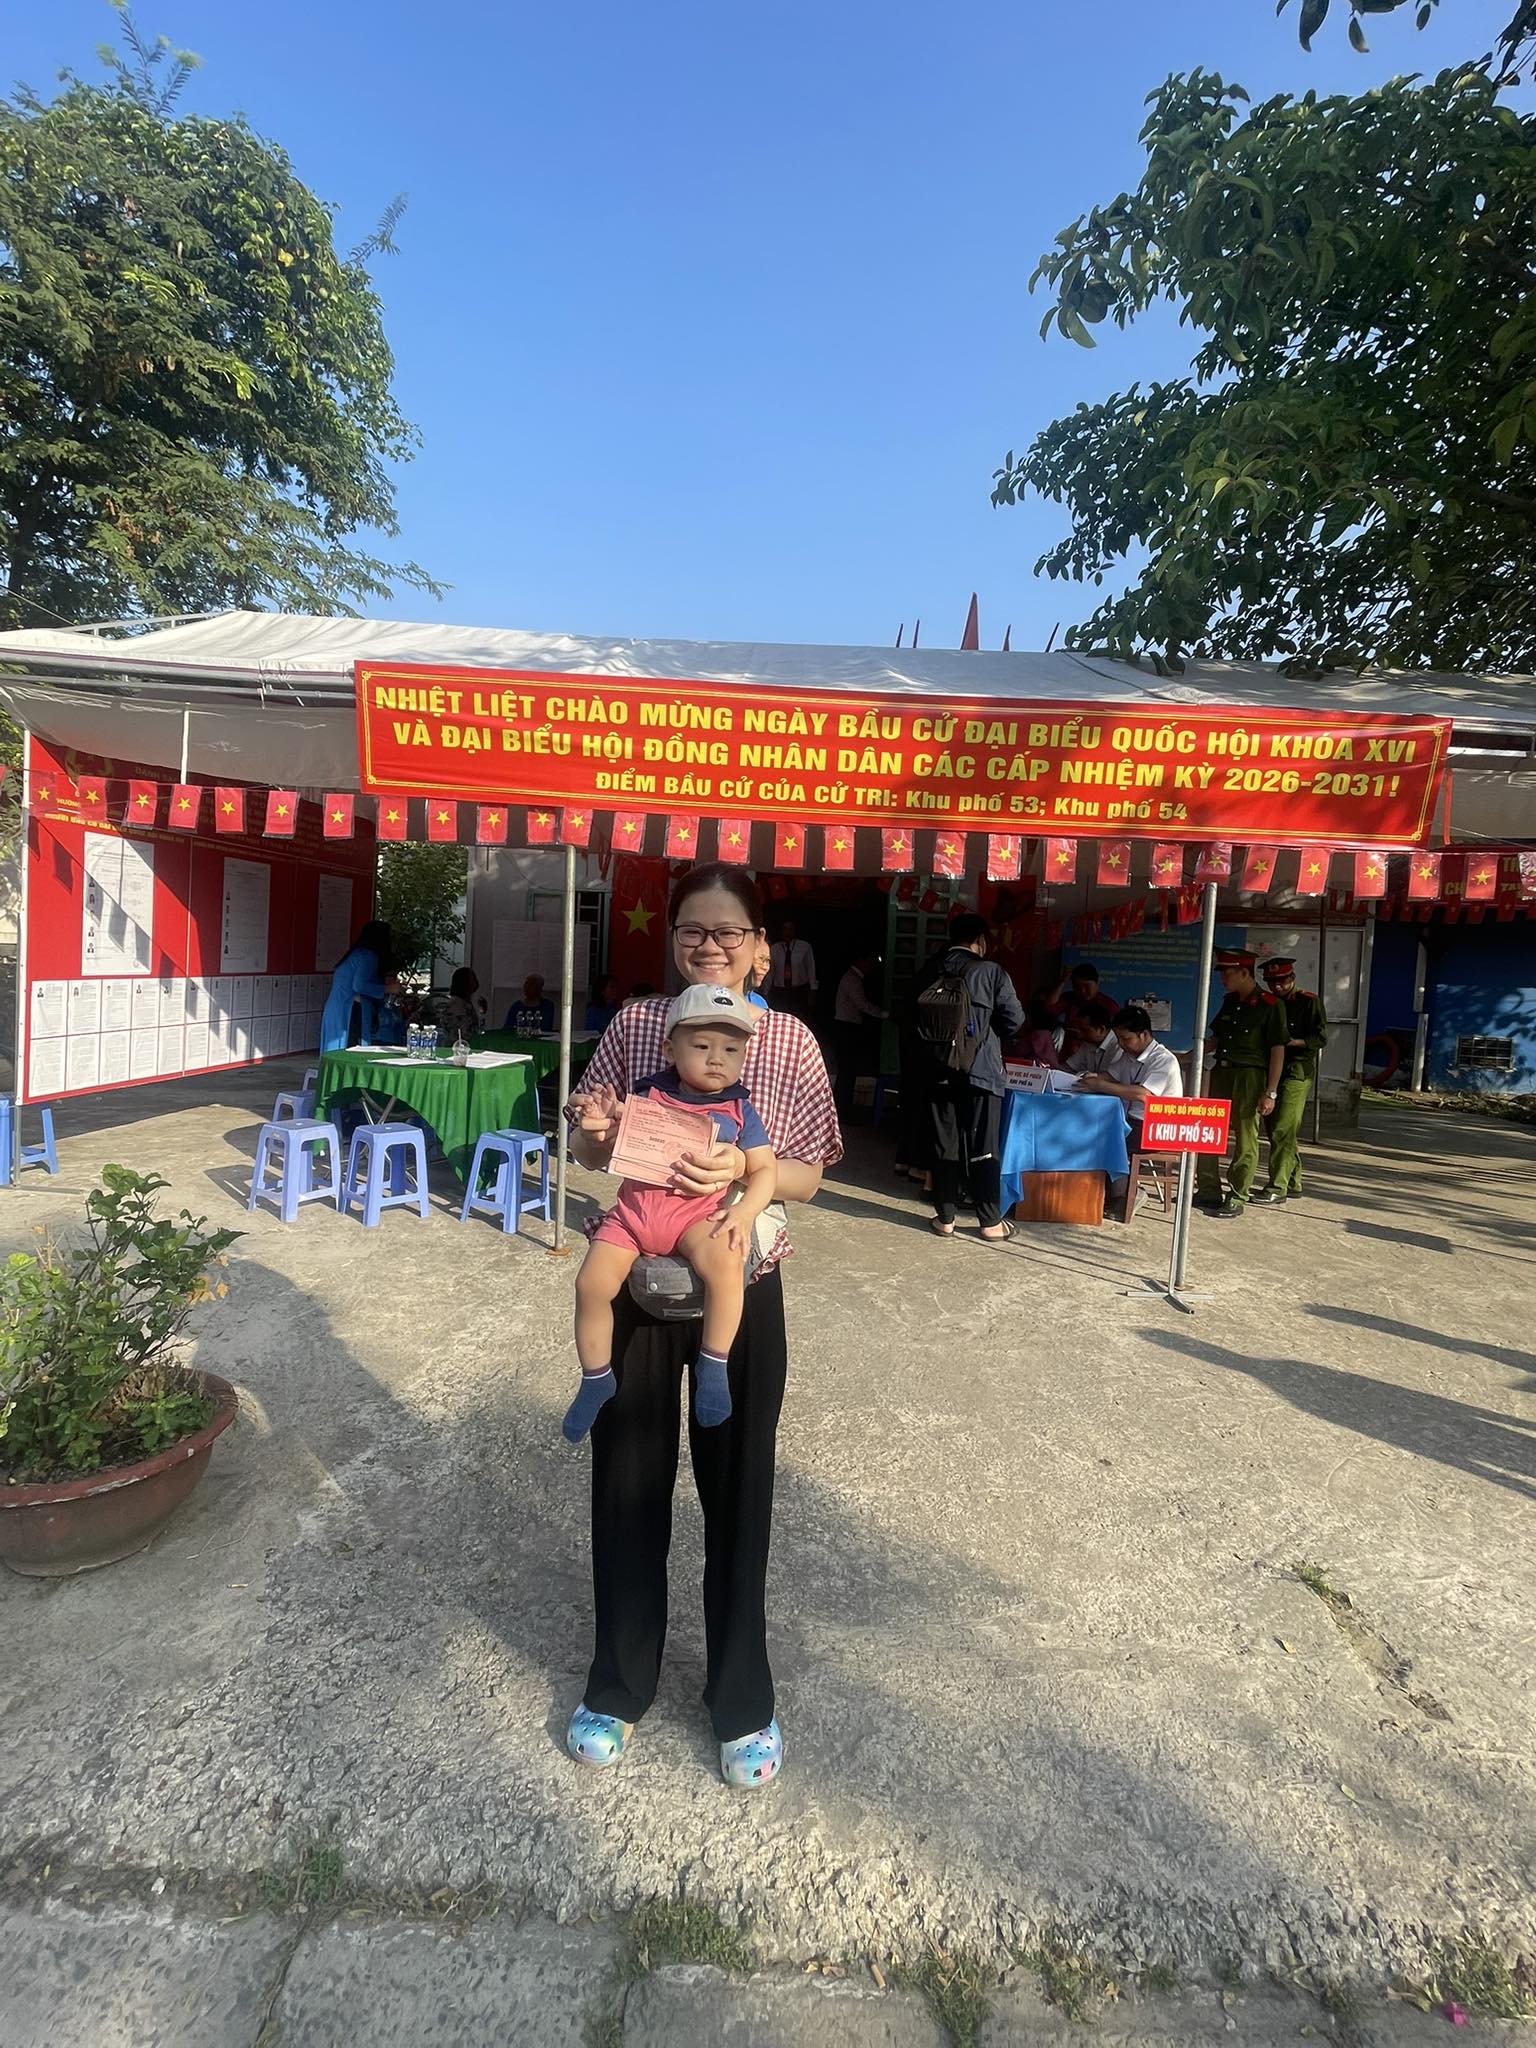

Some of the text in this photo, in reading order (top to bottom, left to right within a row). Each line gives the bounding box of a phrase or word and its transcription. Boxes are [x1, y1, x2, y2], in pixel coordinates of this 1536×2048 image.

[375, 686, 1417, 763] NHIỆT LIỆT CHÀO MỪNG NGÀY BẦU CỬ ĐẠI BIỂU QUỐC HỘI KHÓA XVI
[393, 719, 1400, 798] VÀ ĐẠI BIỂU HỘI ĐỒNG NHÂN DÂN CÁC CẤP NHIỆM KỲ 2026-2031!
[595, 767, 1188, 820] ĐIỂM BẦU CỬ CỦA CỬ TRI: Khu phố 53; Khu phố 54
[1149, 1104, 1163, 1113] KHU
[1164, 1105, 1176, 1116] VỰC
[1188, 1105, 1206, 1117] PHIẾU
[1156, 1123, 1176, 1141] KHU
[1179, 1120, 1201, 1143] PHỐ
